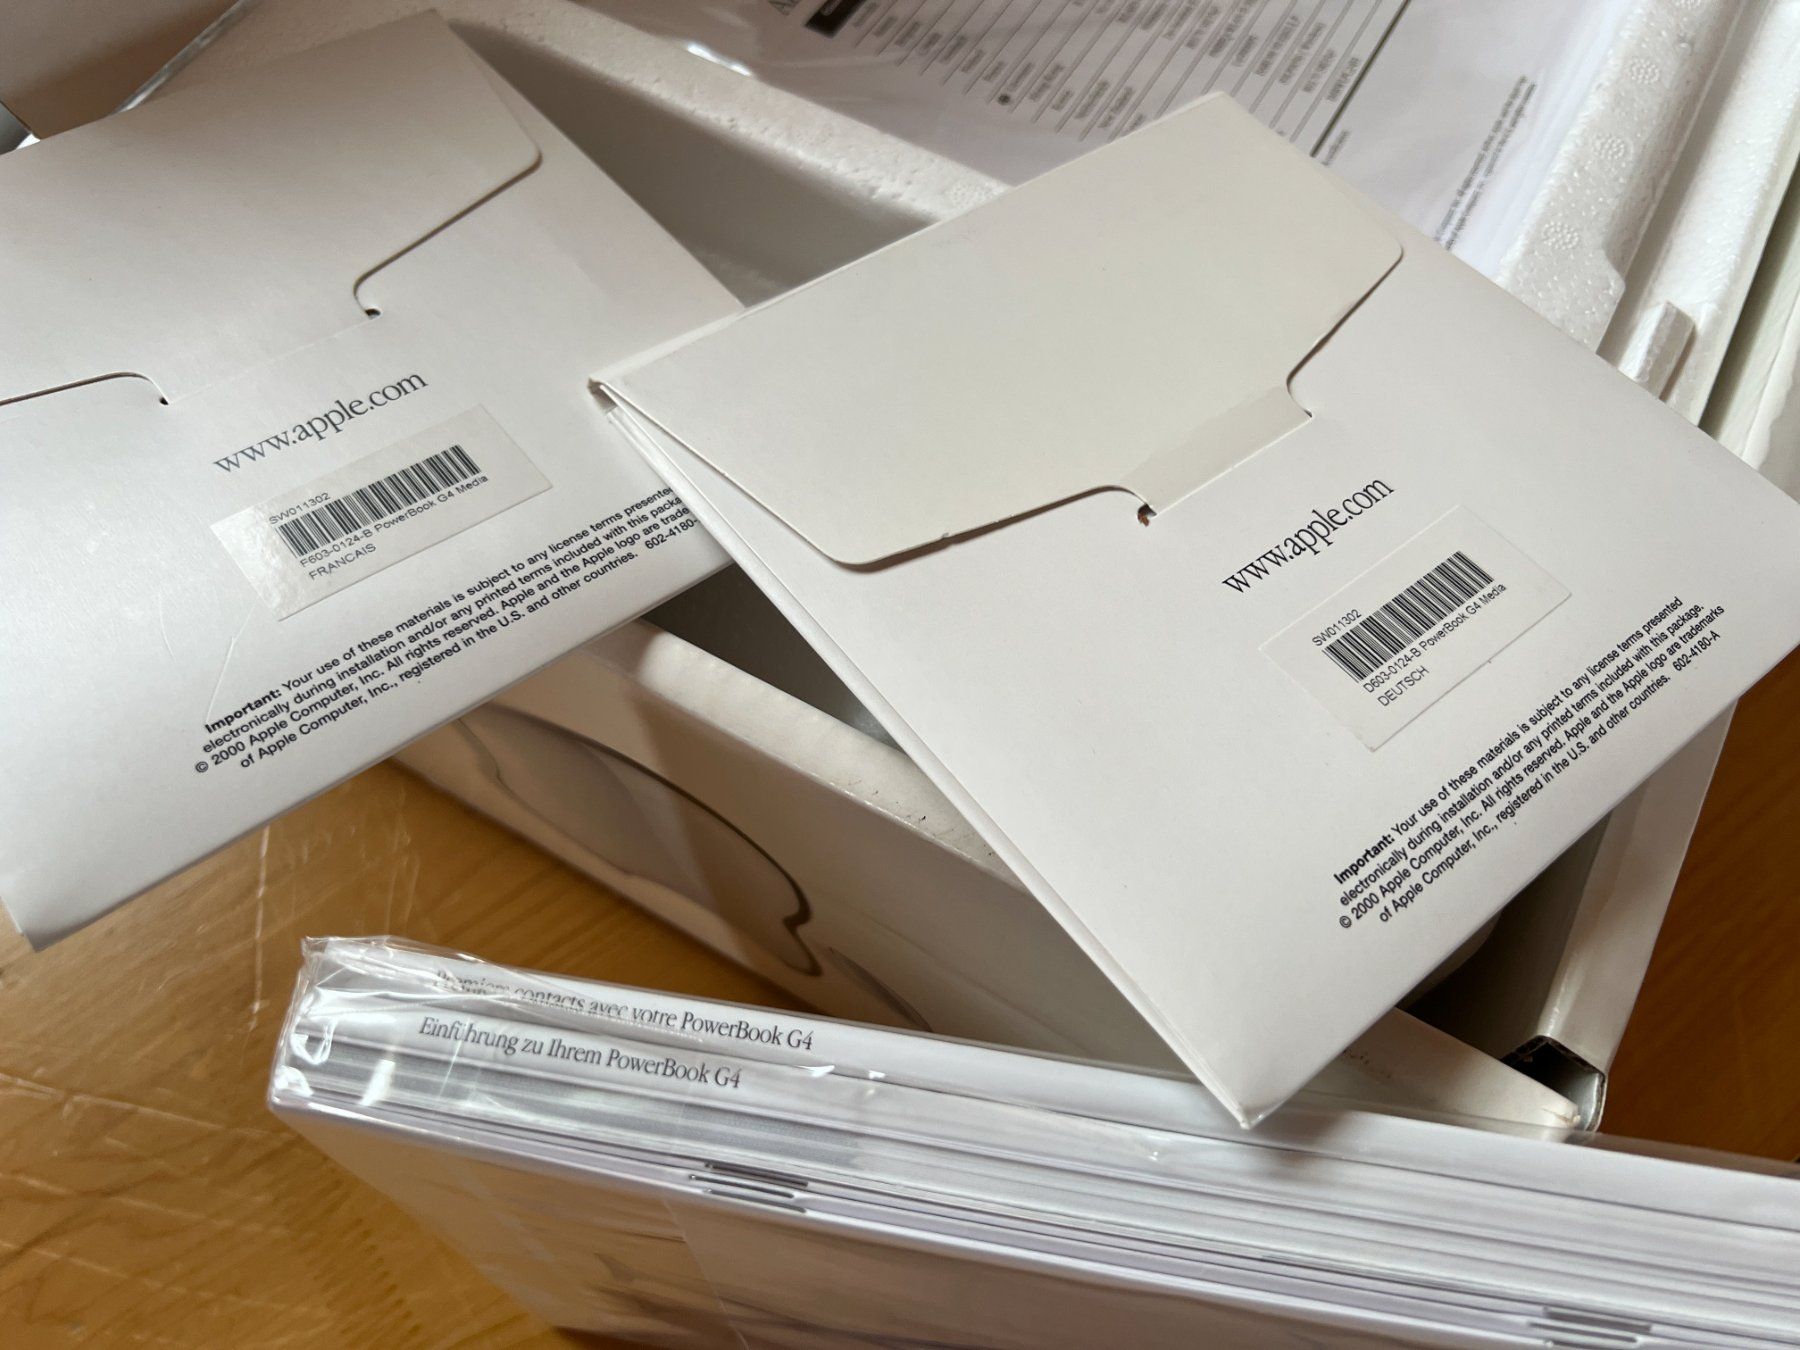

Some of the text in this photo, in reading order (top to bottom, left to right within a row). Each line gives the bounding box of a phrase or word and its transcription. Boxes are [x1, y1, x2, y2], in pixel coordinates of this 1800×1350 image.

[213, 374, 428, 472] www.apple.com
[269, 492, 331, 524] SW011302
[299, 476, 489, 568] F603-0124-B PowerBook G4 Media
[308, 543, 376, 580] FRANCAIS
[1221, 480, 1395, 593] www.apple.com
[202, 496, 682, 753] electronically during installation and/or any printed terms included with this packa
[204, 689, 282, 734] Important:
[281, 671, 313, 691] Your
[316, 658, 340, 675] use
[342, 647, 356, 661] of
[357, 630, 394, 652] these
[395, 600, 452, 633] materials
[451, 593, 466, 603] is
[466, 568, 512, 596] subject
[510, 562, 526, 573] to
[526, 550, 548, 565] any
[548, 529, 590, 553] license
[589, 512, 623, 532] terms
[210, 741, 246, 766] 2000
[249, 720, 288, 747] Apple
[289, 682, 359, 722] Computer,
[358, 670, 385, 685] Inc.
[386, 655, 404, 672] All
[404, 638, 442, 661] rights
[442, 606, 500, 641] reserved.
[500, 588, 536, 611] Apple
[536, 573, 560, 591] and
[559, 564, 581, 578] the
[581, 546, 615, 568] Apple
[613, 533, 641, 550] logo
[642, 523, 661, 536] are
[660, 507, 690, 526] trade
[240, 518, 699, 768] of Apple Computer, Inc., registered in the U.S. and other countries. 602-4180-
[1312, 609, 1362, 646] SW011302
[1362, 584, 1507, 693] D603-0124-B PowerBook G4 Media
[1333, 596, 1683, 885] Important: Your use of these materials is subject to any license terms presented
[1377, 665, 1429, 707] DEUTSCH
[1340, 604, 1704, 906] electronically during installation and/or any printed terms included with this package.
[1351, 892, 1380, 920] 2000
[1379, 868, 1412, 898] Apple
[1409, 825, 1464, 870] Computer,
[1459, 810, 1483, 828] Inc.
[1480, 794, 1497, 812] All
[1495, 773, 1524, 800] rights
[1522, 737, 1566, 777] reserved.
[1563, 716, 1592, 742] Apple
[1590, 699, 1610, 720] and
[1606, 689, 1624, 705] the
[1621, 668, 1649, 693] Apple
[1644, 653, 1668, 672] logo
[1666, 641, 1682, 656] are
[1678, 605, 1725, 644] trademarks
[1379, 630, 1721, 922] of Apple Computer, Inc., registered in the U.S. and other countries. 602-4180-A
[521, 1038, 544, 1055] zu
[546, 1039, 602, 1065] Ihrem
[606, 1048, 711, 1084] PowerBook
[714, 1066, 742, 1089] G4
[632, 1006, 678, 1027] votre
[680, 1011, 784, 1046] PowerBook
[786, 1029, 814, 1051] G4
